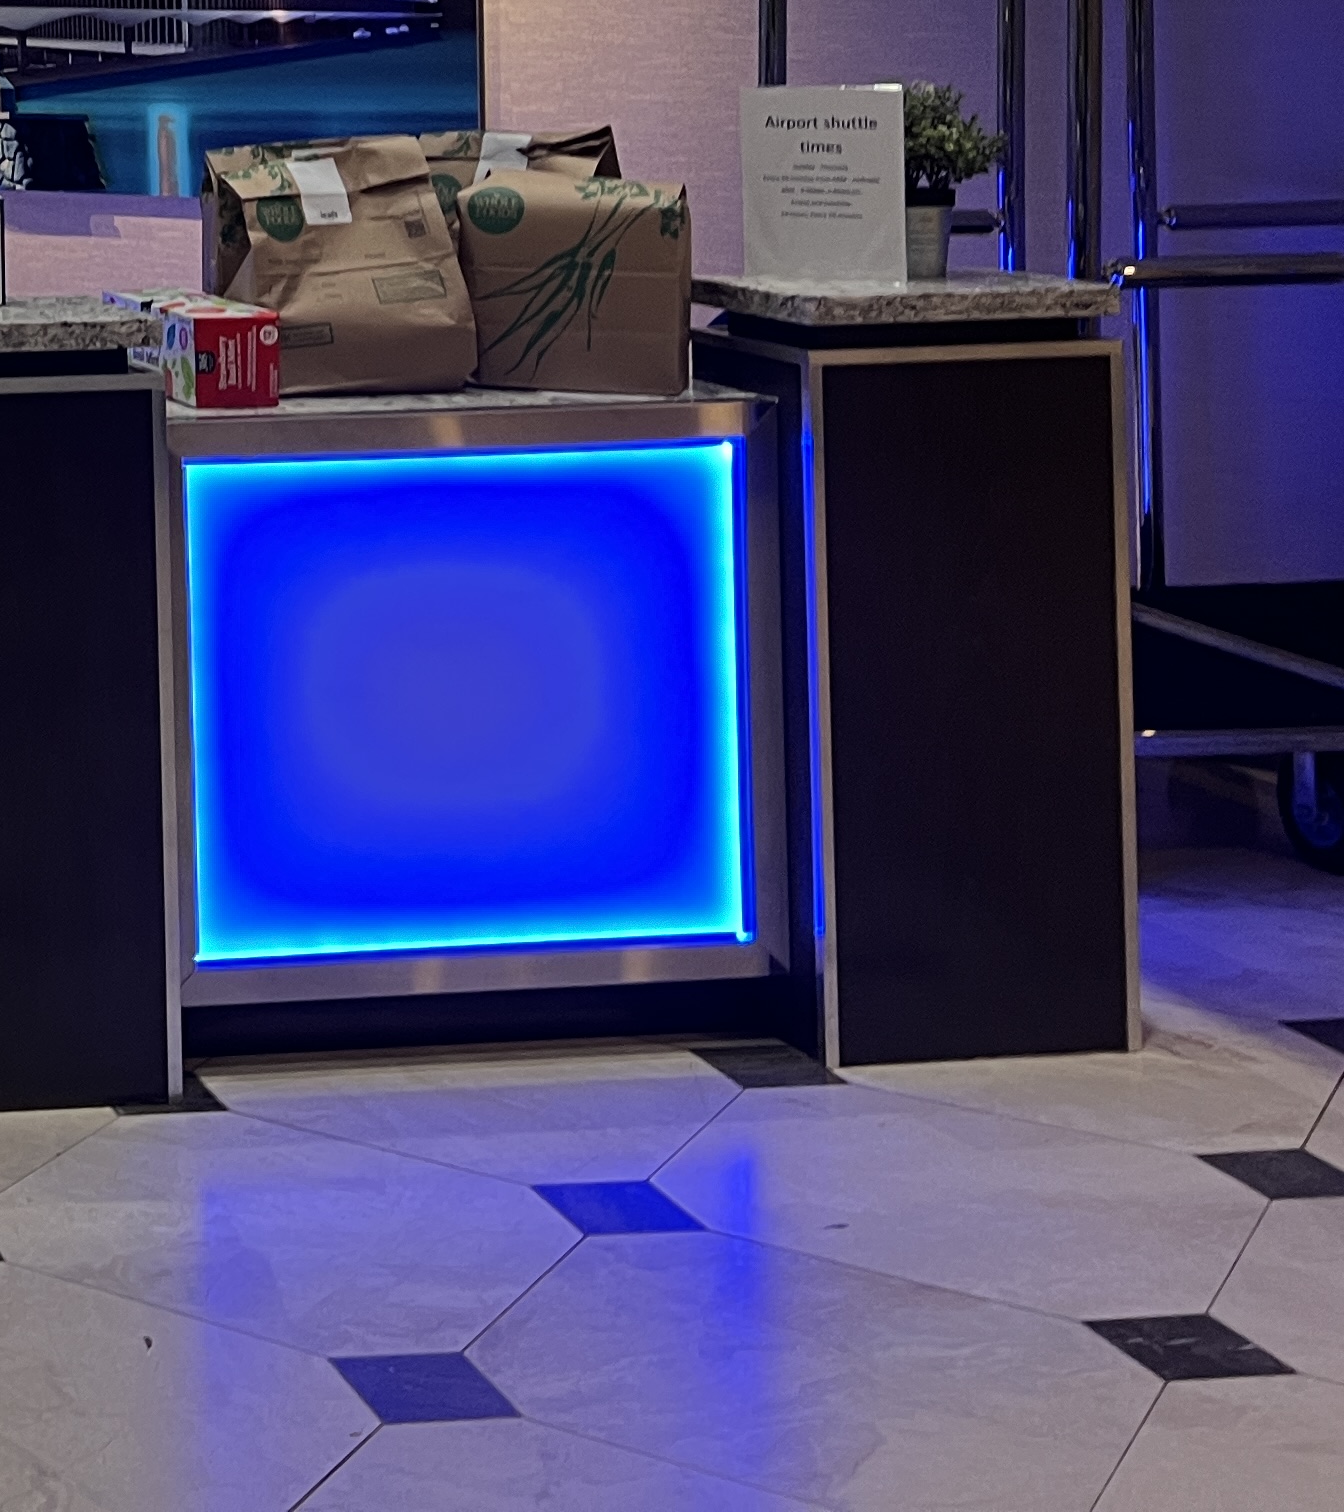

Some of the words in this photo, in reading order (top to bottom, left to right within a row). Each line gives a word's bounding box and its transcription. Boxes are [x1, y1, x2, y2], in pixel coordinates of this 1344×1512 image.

[765, 115, 818, 131] Airport
[823, 115, 878, 131] shuttle
[800, 140, 843, 155] times
